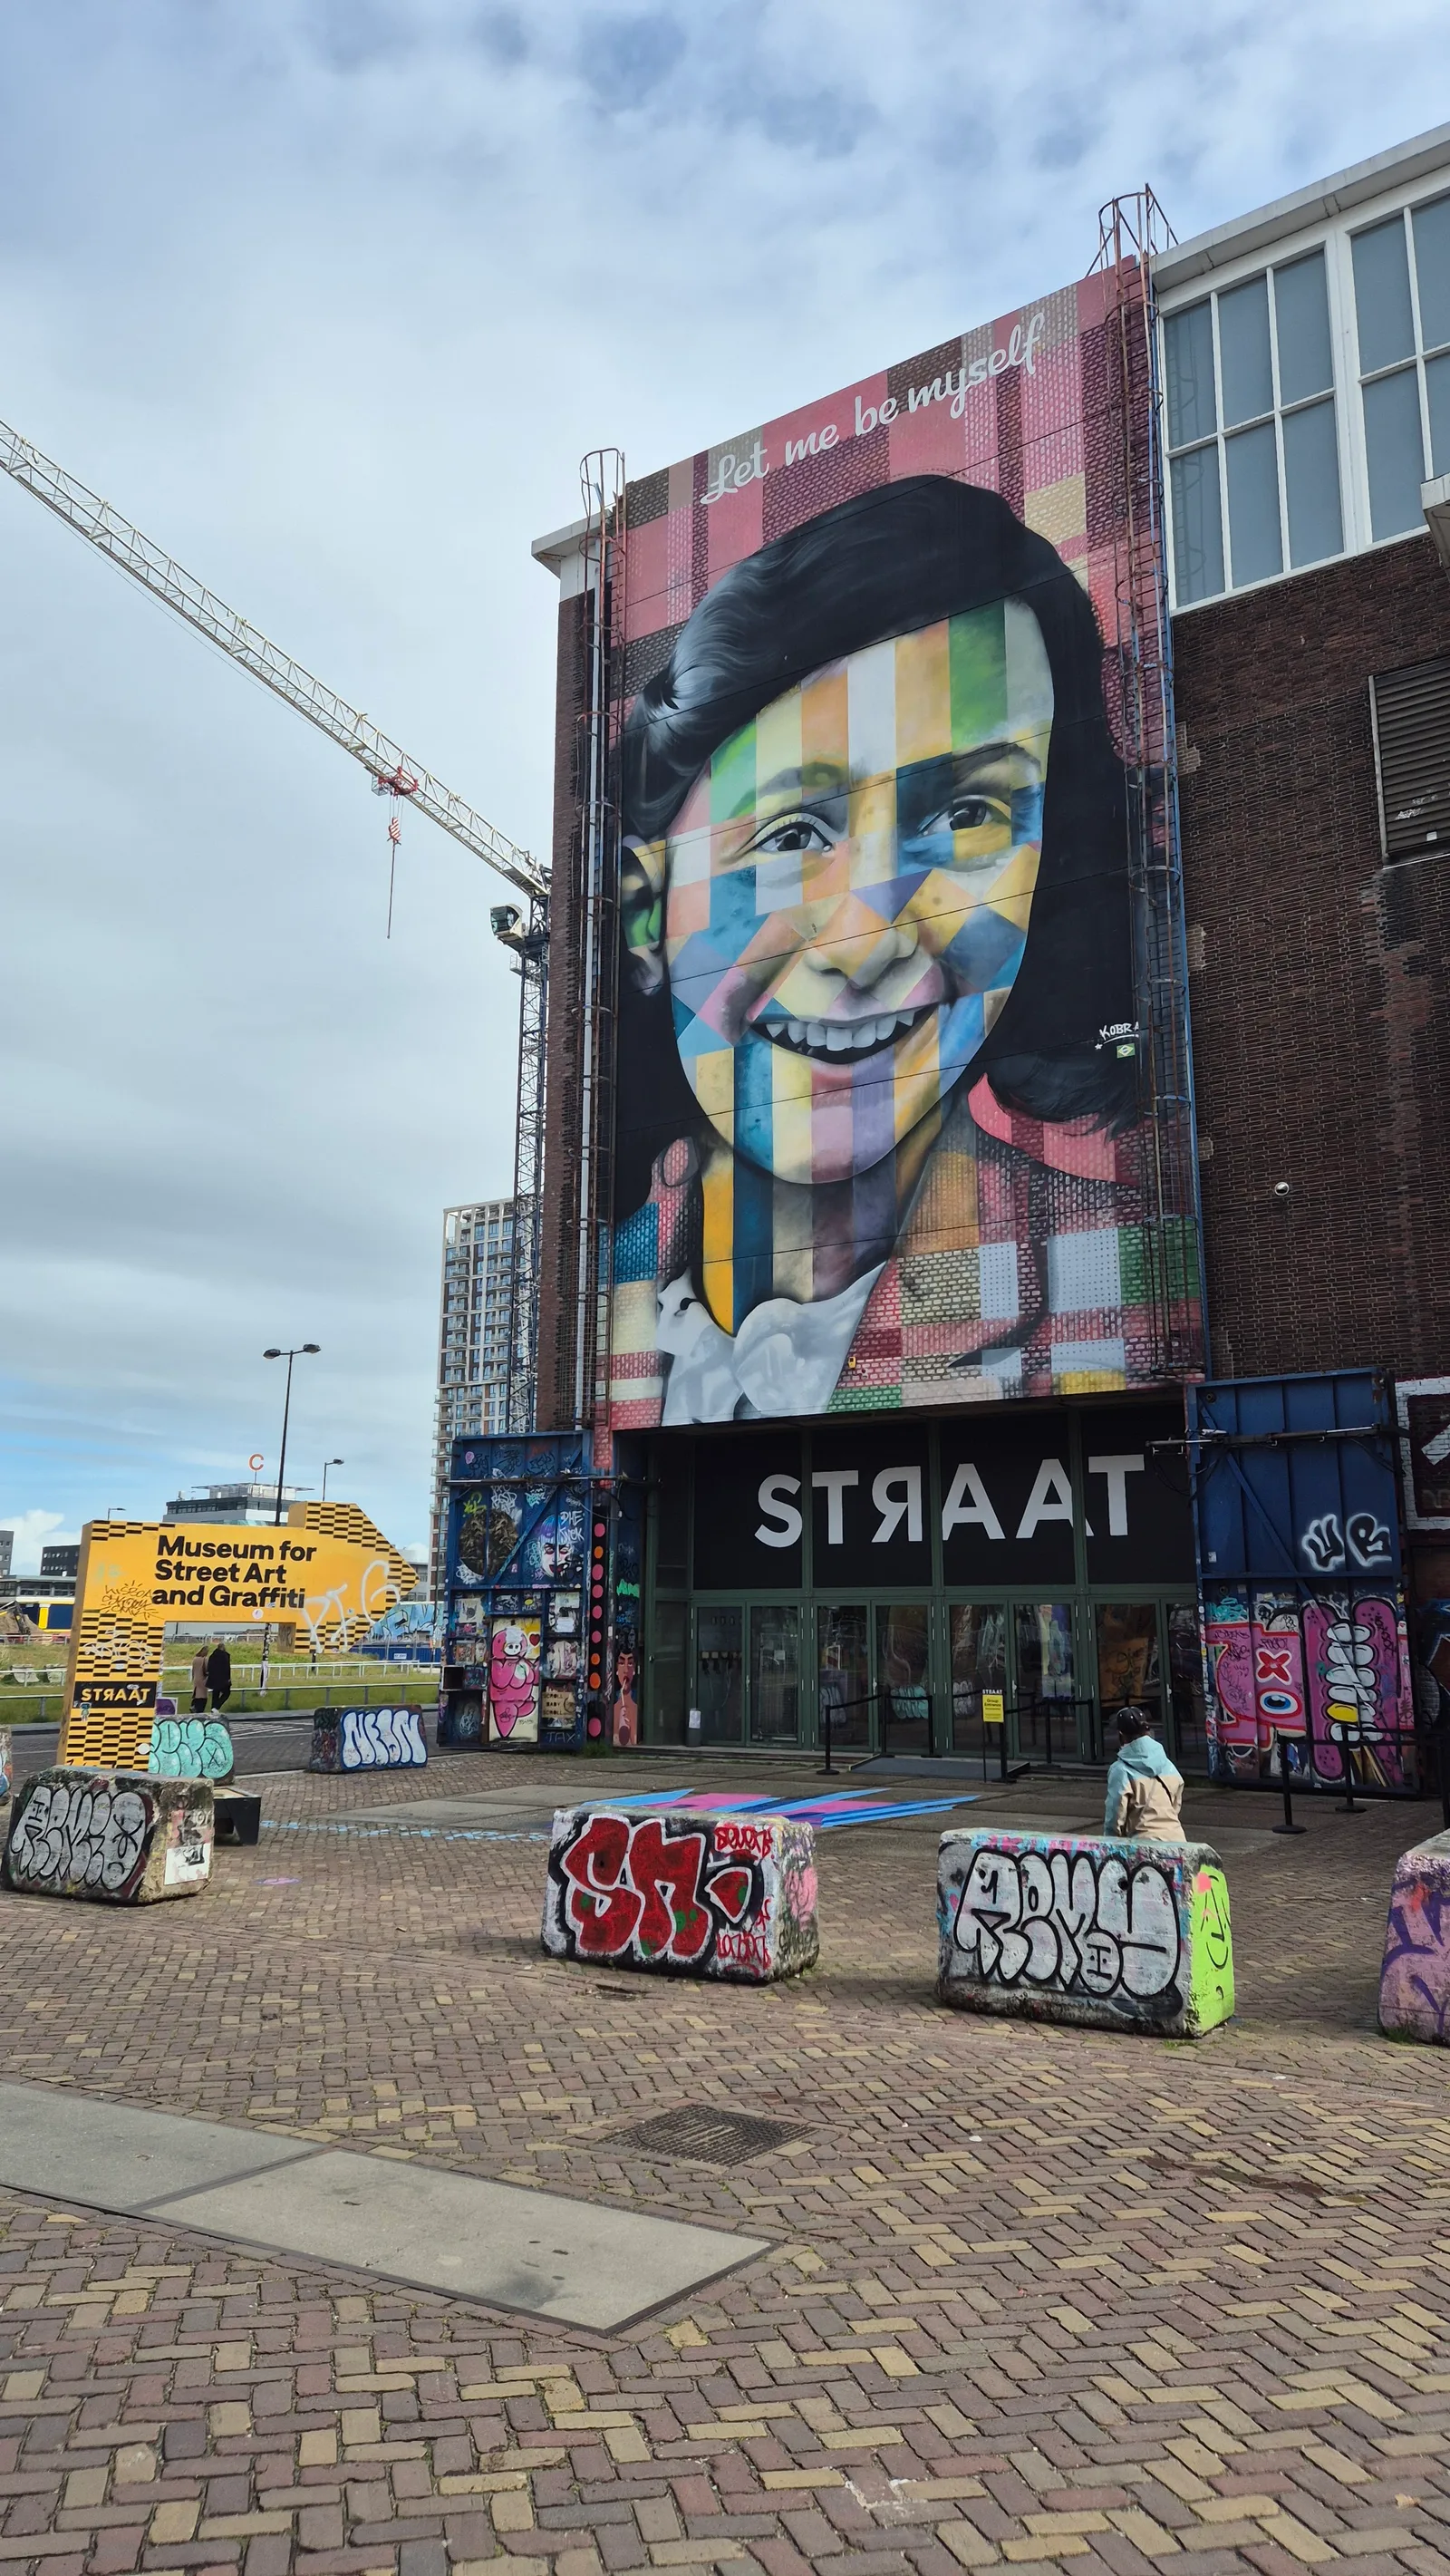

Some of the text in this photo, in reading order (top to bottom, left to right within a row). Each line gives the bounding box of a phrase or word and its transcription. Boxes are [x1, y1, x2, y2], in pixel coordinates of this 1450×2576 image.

[700, 312, 1046, 506] Let me be myself
[1098, 1021, 1140, 1041] KOBRA
[754, 1454, 1145, 1548] STRAAT
[157, 1535, 317, 1562] Museum for
[155, 1559, 287, 1584] Street Art
[151, 1584, 306, 1609] and Graffiti
[81, 1688, 150, 1702] STRAAT
